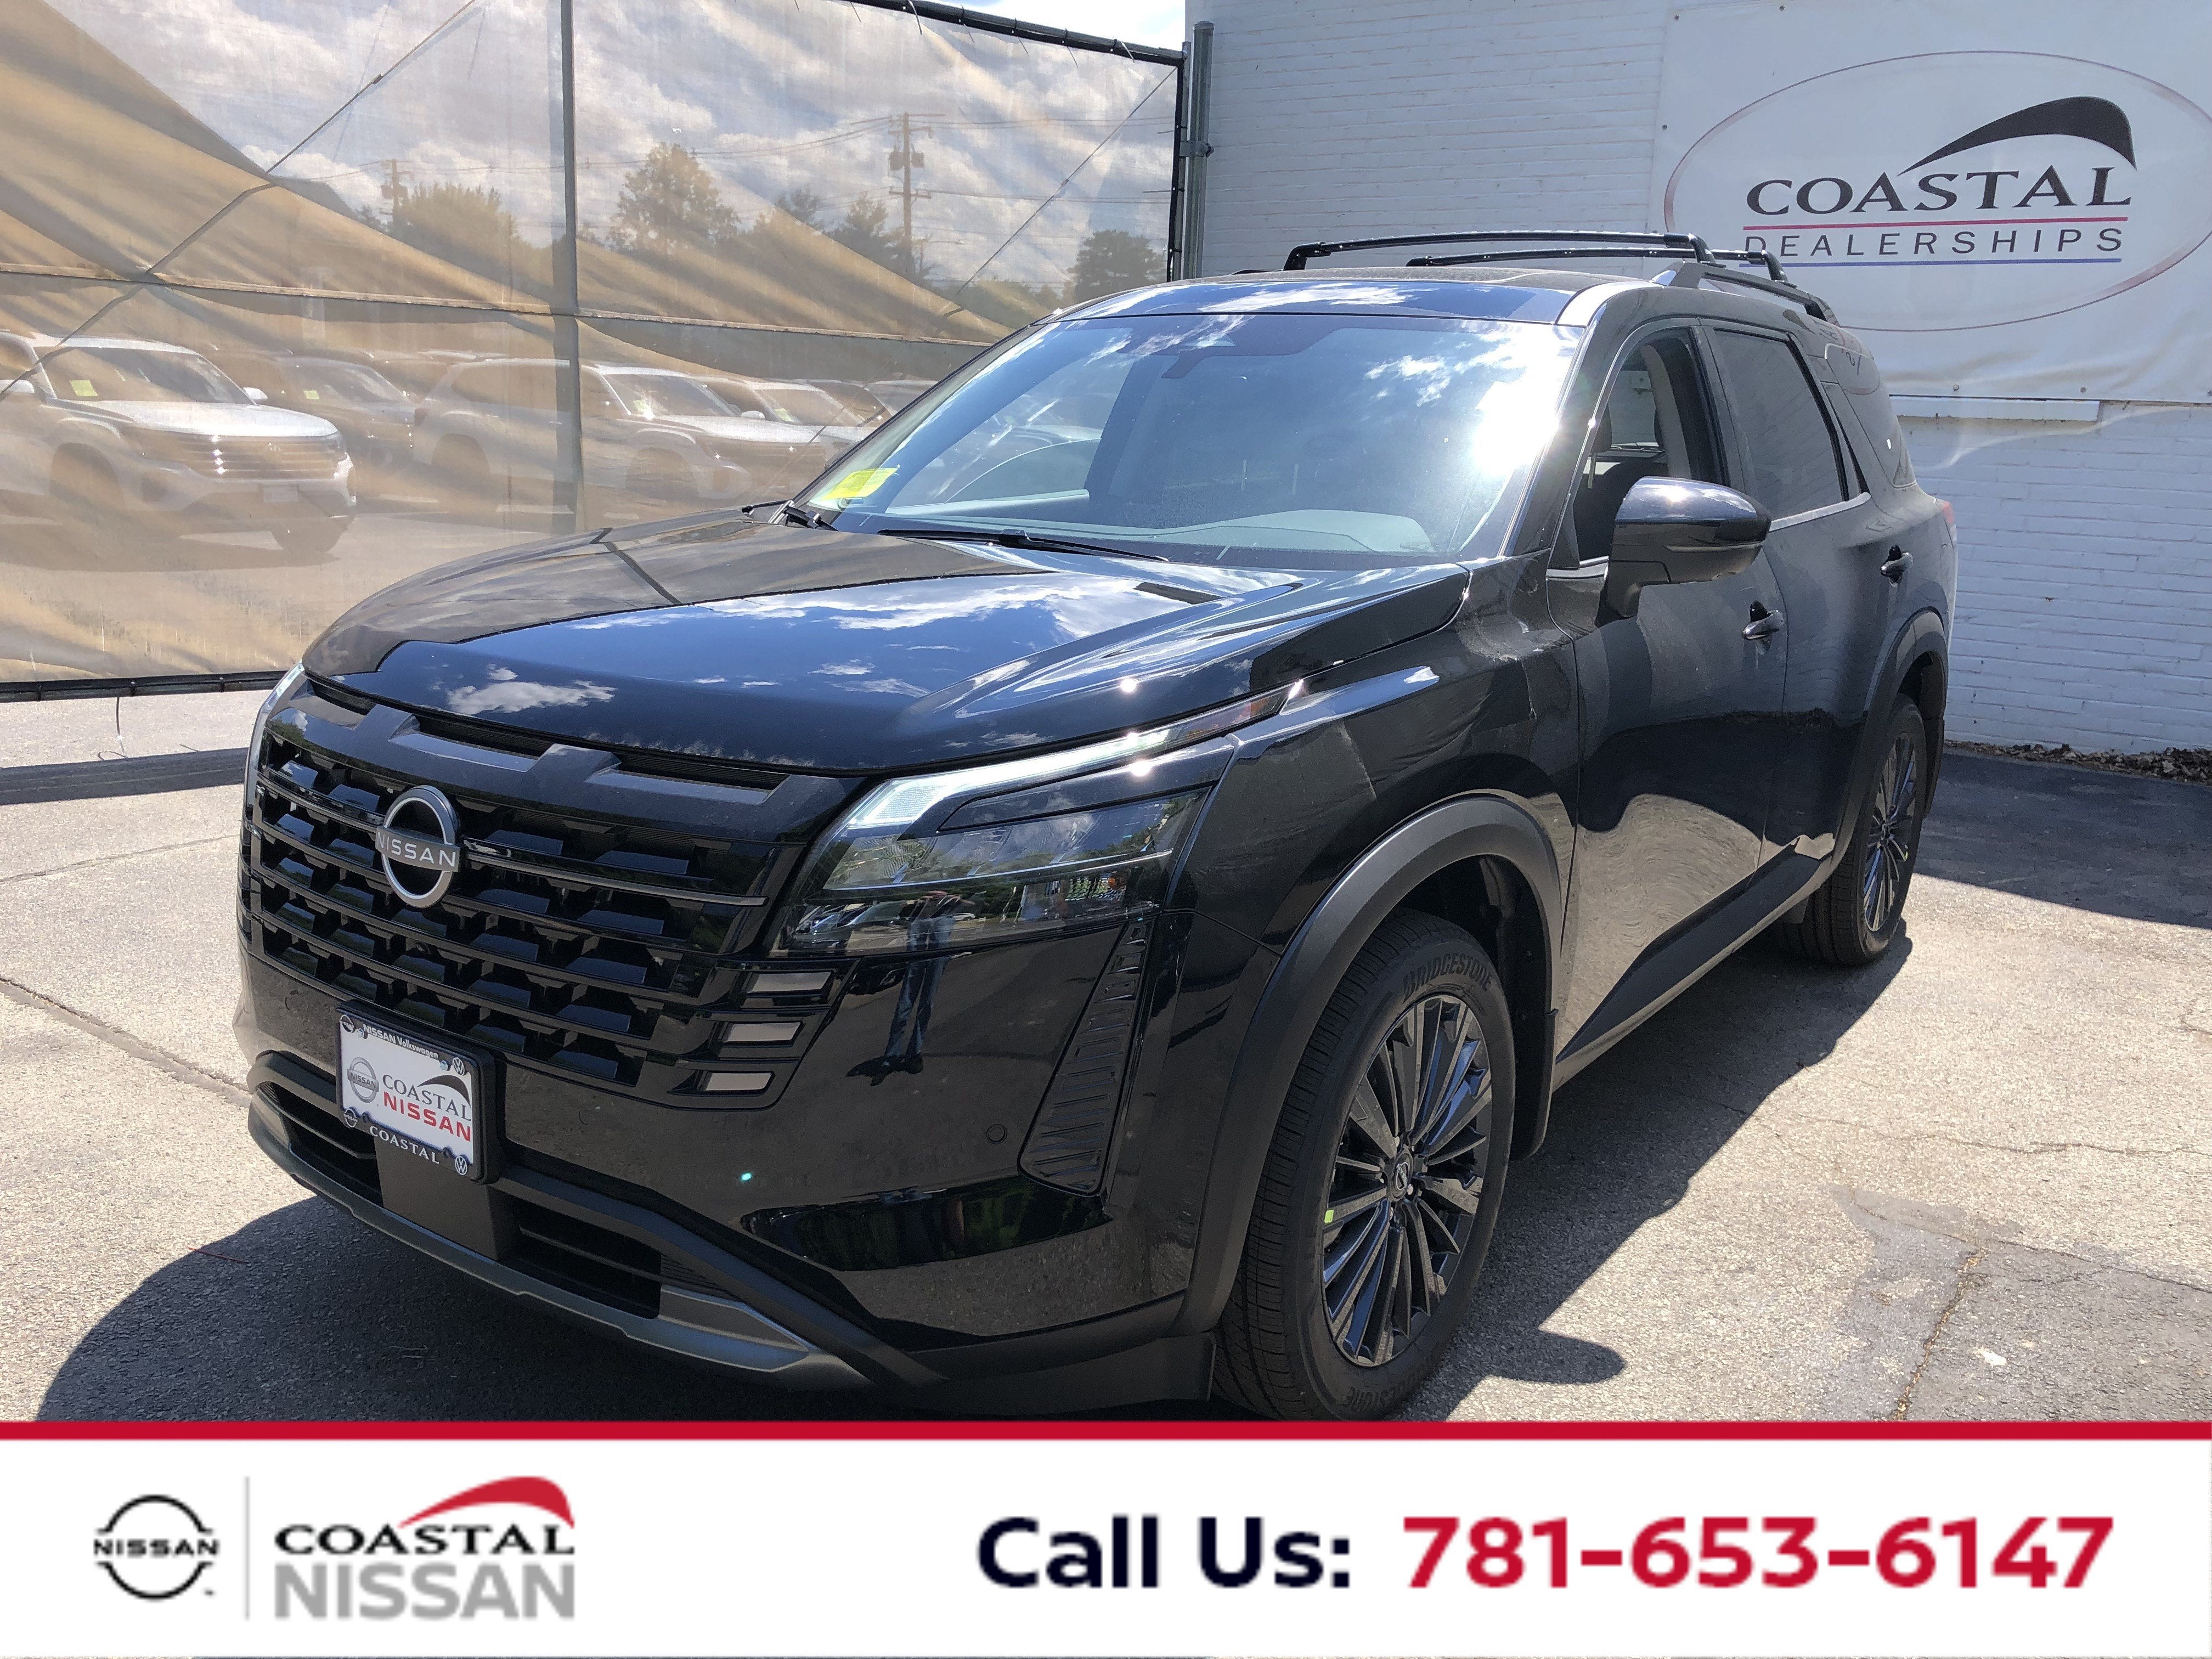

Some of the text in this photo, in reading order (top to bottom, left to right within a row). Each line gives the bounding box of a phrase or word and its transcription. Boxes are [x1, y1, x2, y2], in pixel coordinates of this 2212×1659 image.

[1747, 164, 2132, 216] COASTAL
[1745, 228, 2123, 256] DEALERSHIPS
[376, 831, 456, 867] NISSAN
[1402, 951, 1492, 1004] BRIDGESTONE
[363, 1023, 396, 1044] NISSAN
[397, 1035, 439, 1059] Volkswagen
[349, 1071, 377, 1089] NISSAN
[382, 1074, 472, 1122] COASTAL
[383, 1091, 471, 1142] NISSAN
[369, 1125, 439, 1164] COASTAL
